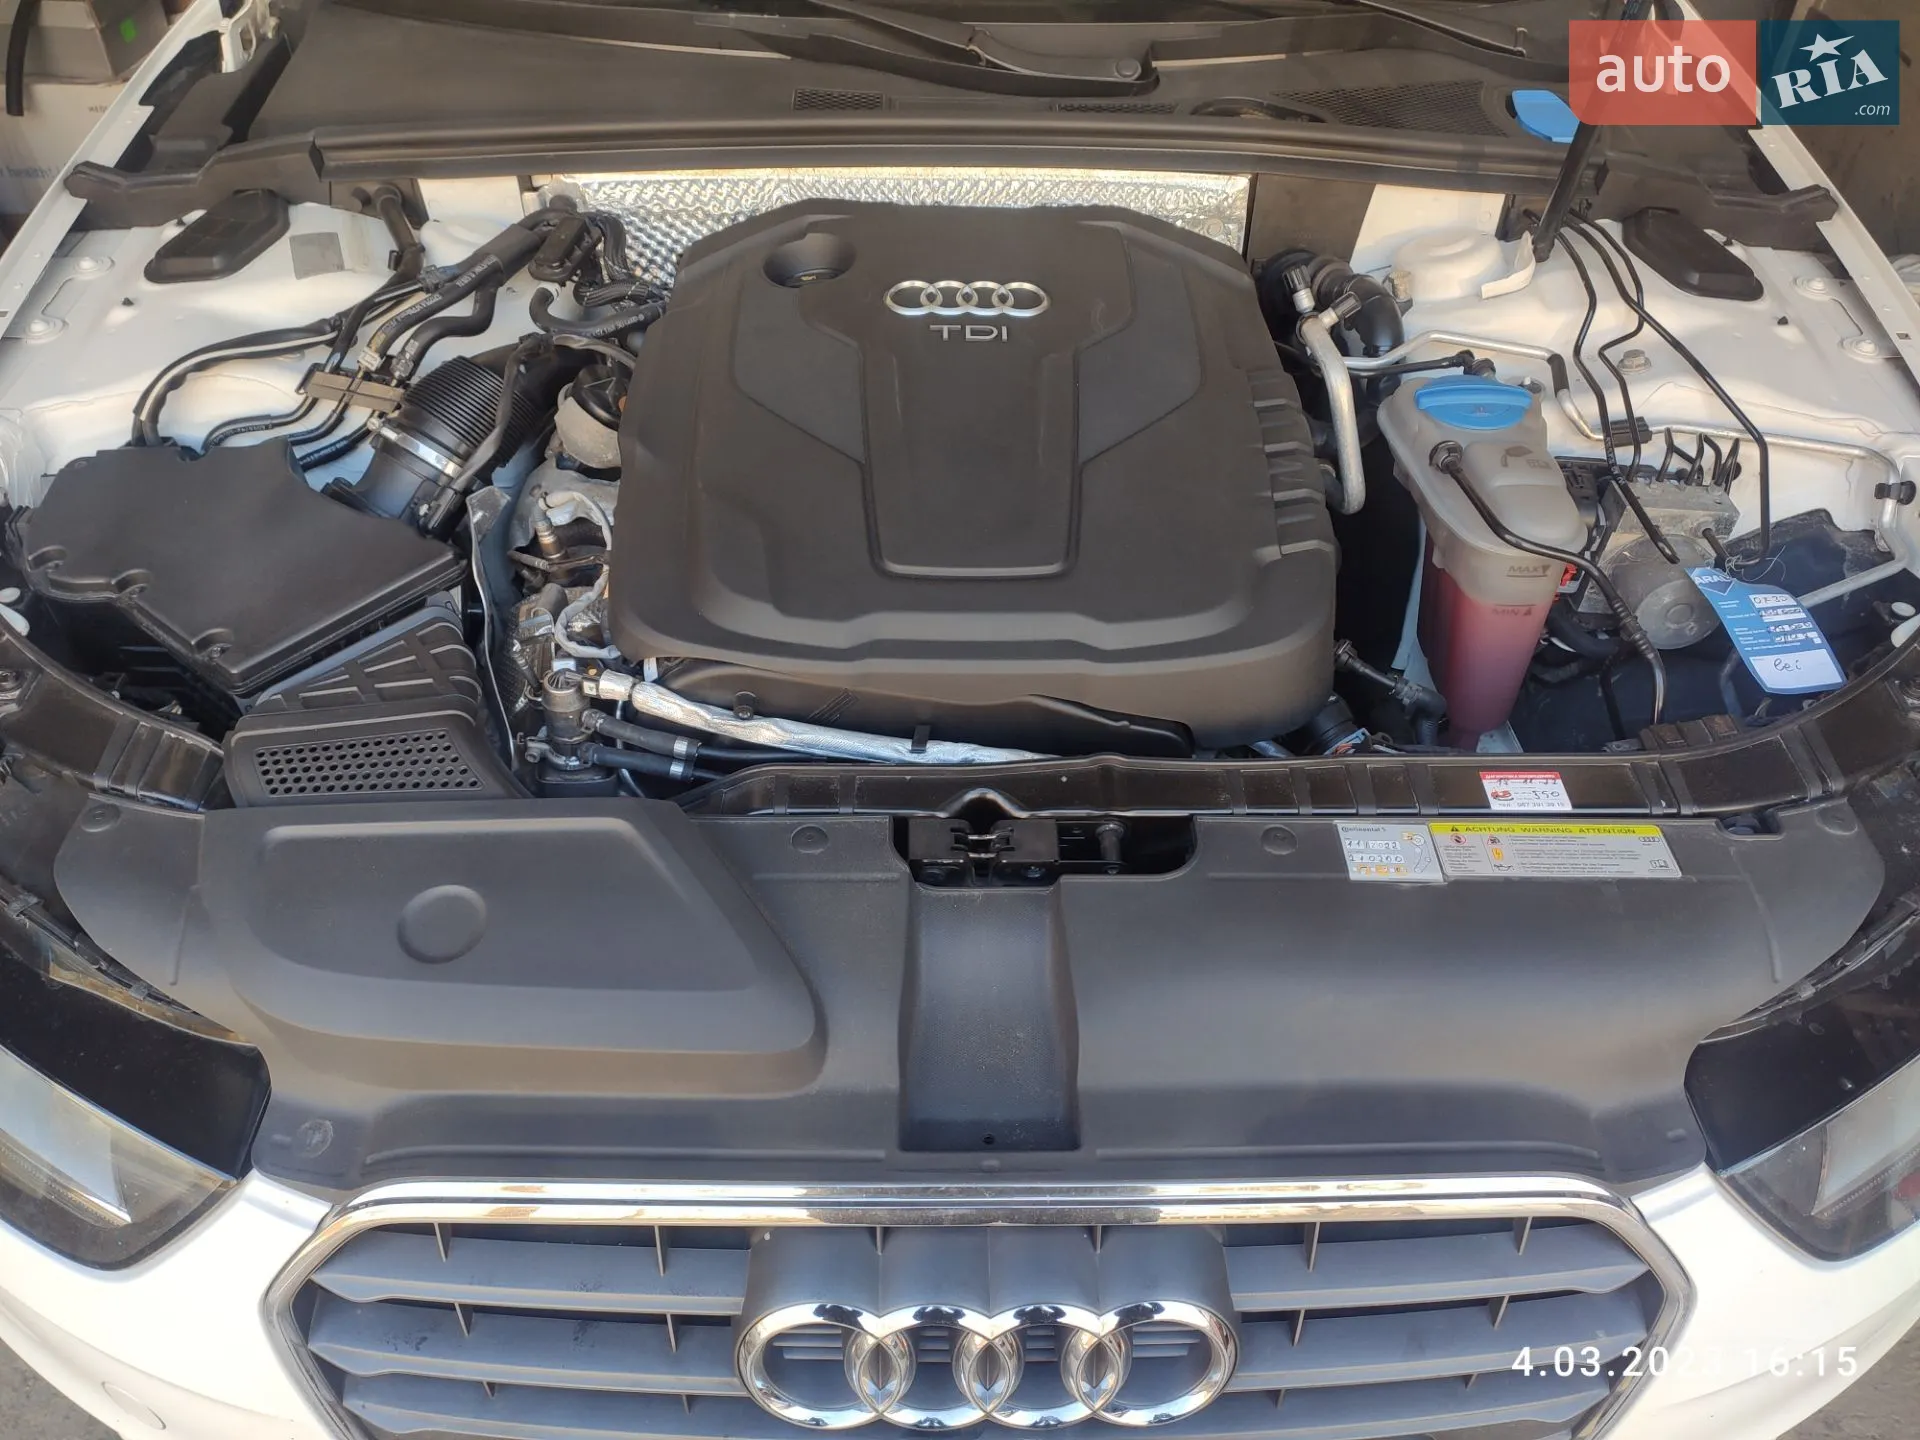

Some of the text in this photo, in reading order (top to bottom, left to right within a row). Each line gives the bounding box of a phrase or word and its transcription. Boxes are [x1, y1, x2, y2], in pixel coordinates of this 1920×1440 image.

[929, 324, 1008, 343] TDI
[1507, 565, 1540, 574] MAX
[1491, 607, 1520, 616] MIN
[1520, 826, 1573, 834] WARNING
[1578, 826, 1636, 834] ATTENTION
